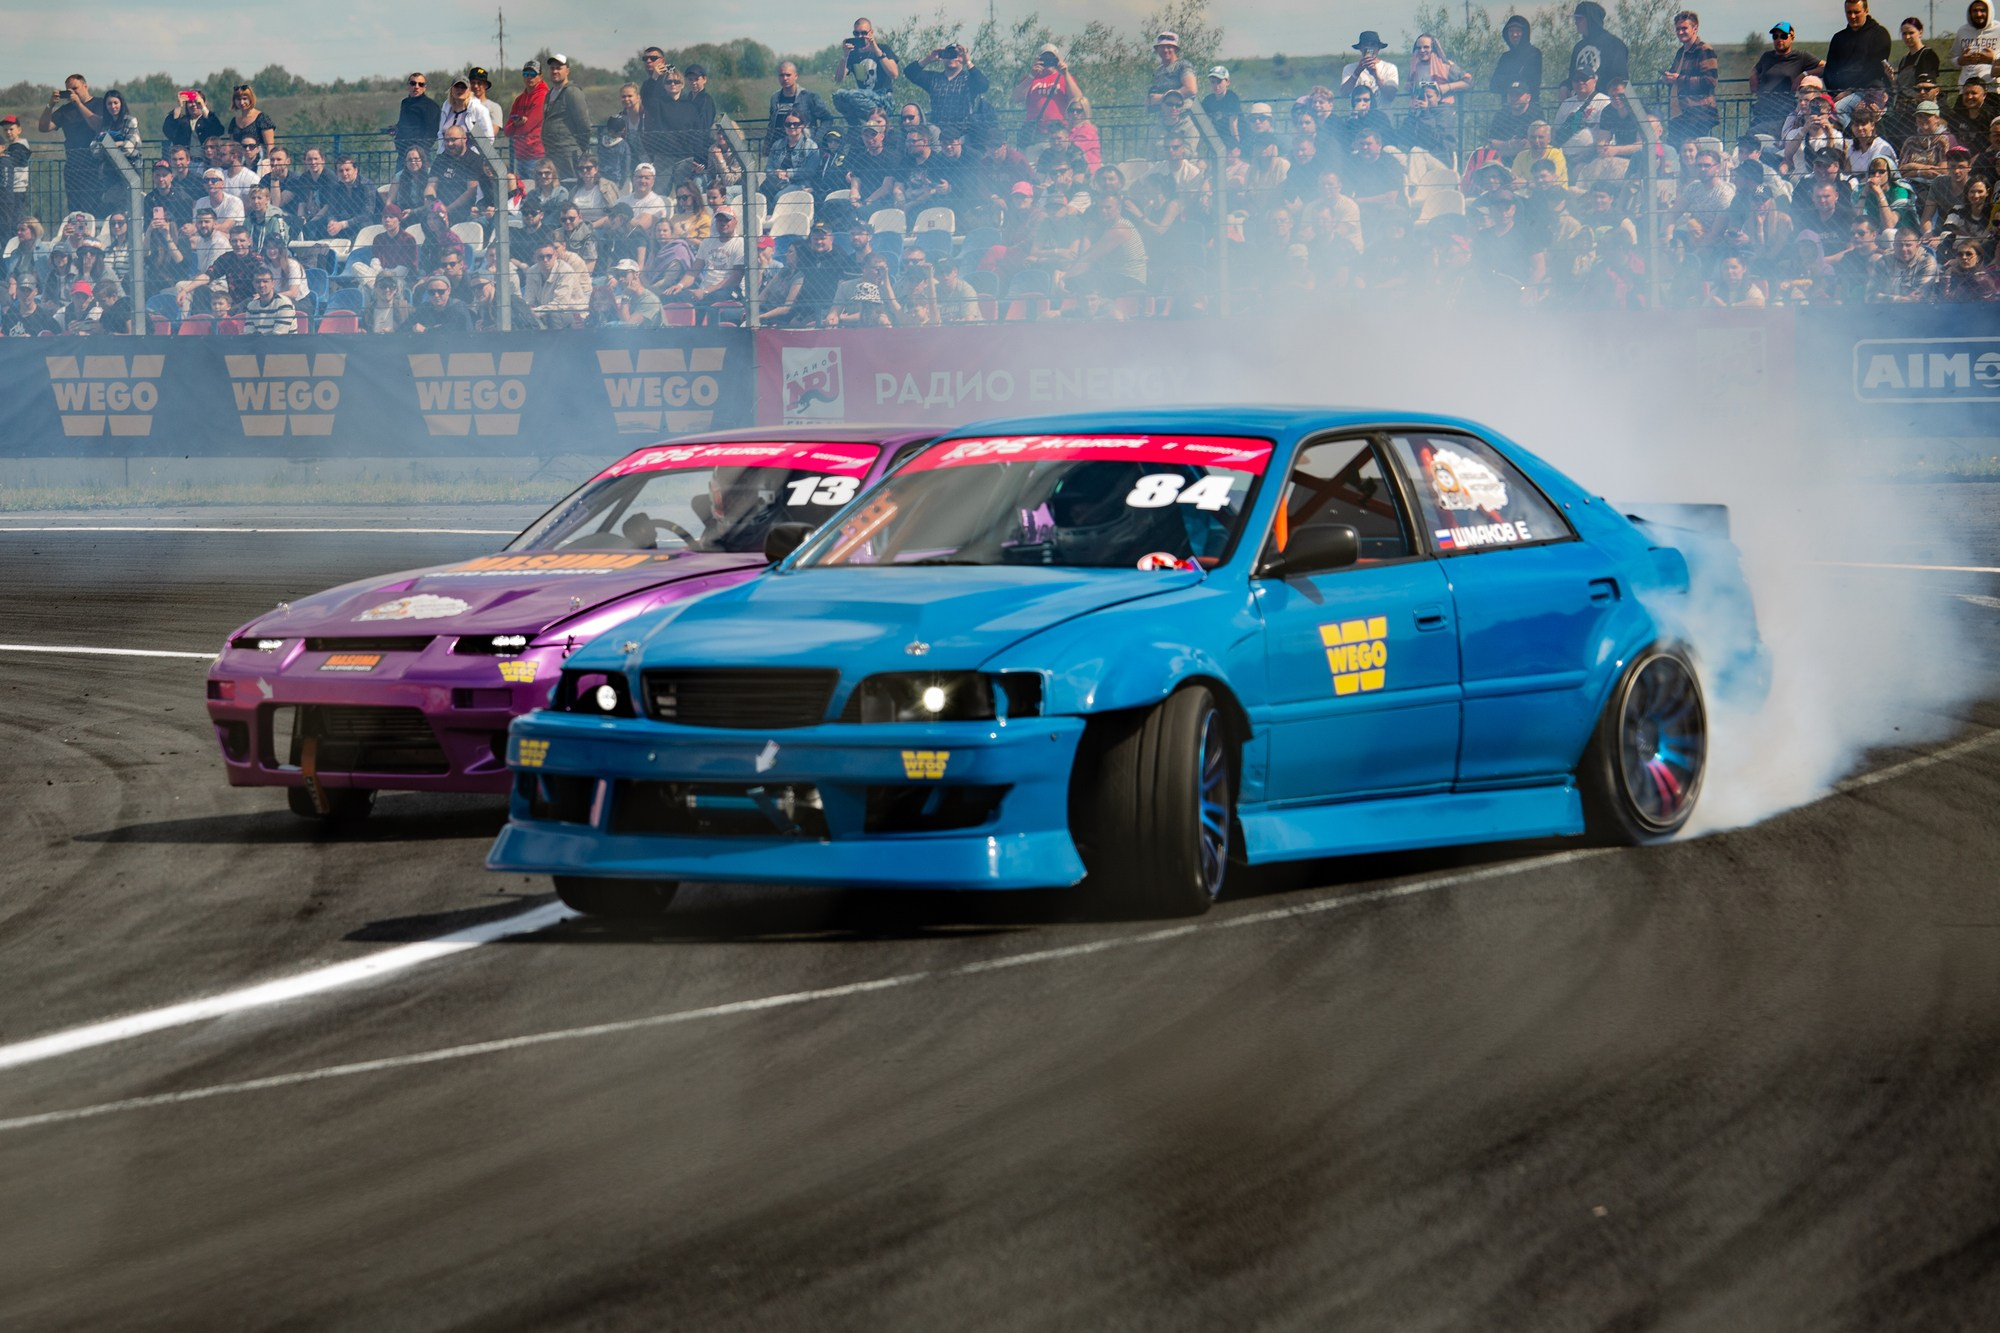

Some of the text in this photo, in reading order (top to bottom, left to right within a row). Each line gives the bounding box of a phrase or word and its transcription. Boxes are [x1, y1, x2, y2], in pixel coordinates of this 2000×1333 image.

[52, 381, 159, 412] WEGO
[232, 379, 340, 411] WEGO
[415, 378, 527, 411] WEGO
[603, 375, 719, 409] WEGO
[875, 367, 1189, 409] РАДИО ENERGY
[787, 476, 860, 506] 13
[1125, 473, 1236, 511] 84
[1450, 522, 1518, 548] ШМАКОВ
[1326, 640, 1387, 674] WEGO
